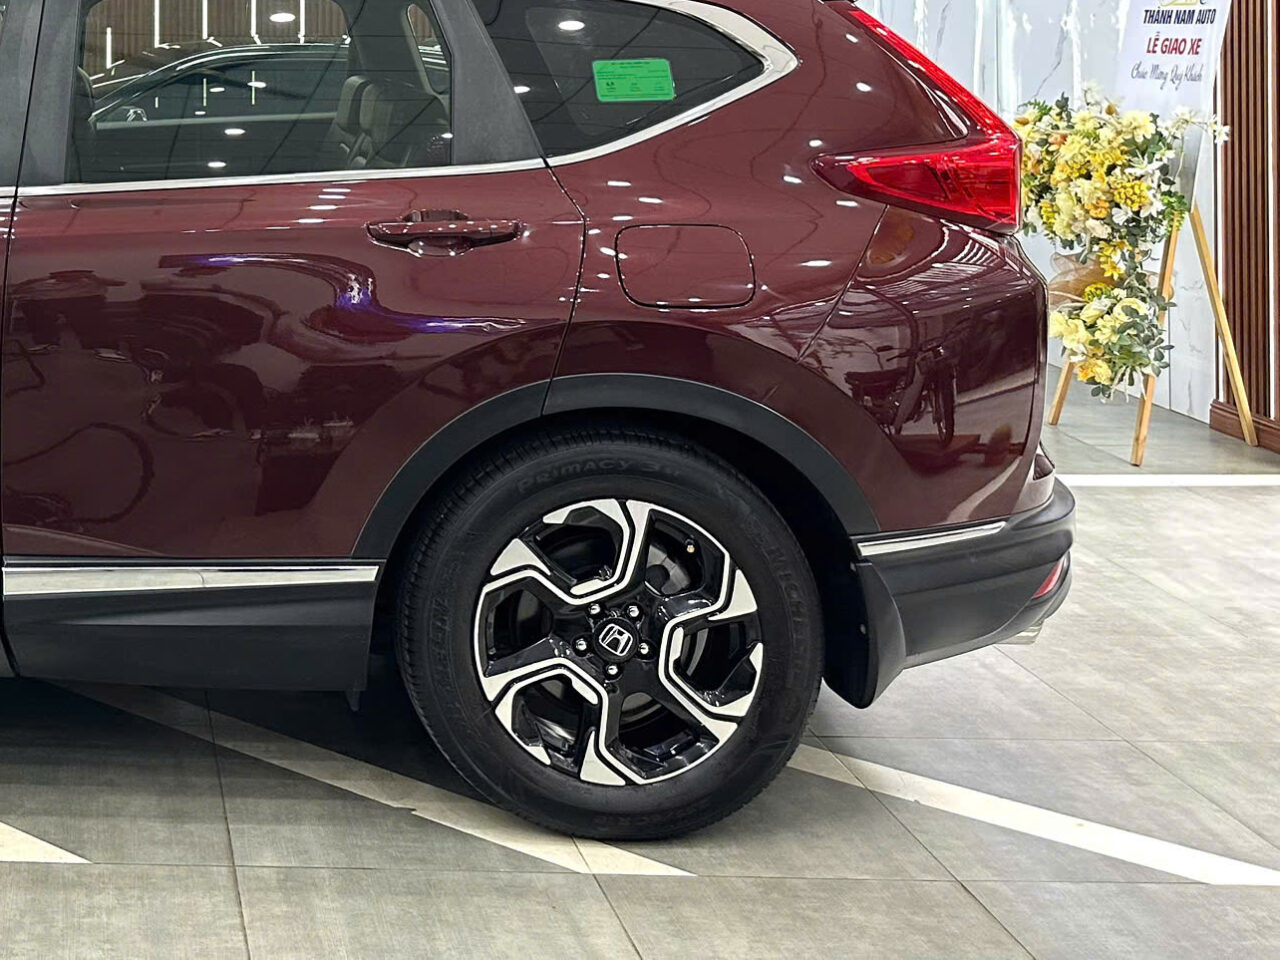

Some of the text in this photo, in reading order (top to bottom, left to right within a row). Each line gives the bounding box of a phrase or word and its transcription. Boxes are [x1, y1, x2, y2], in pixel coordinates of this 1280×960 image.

[1174, 10, 1195, 25] NAM
[1195, 9, 1216, 25] AUTO
[1160, 38, 1187, 55] GIAO
[1187, 38, 1202, 55] XE
